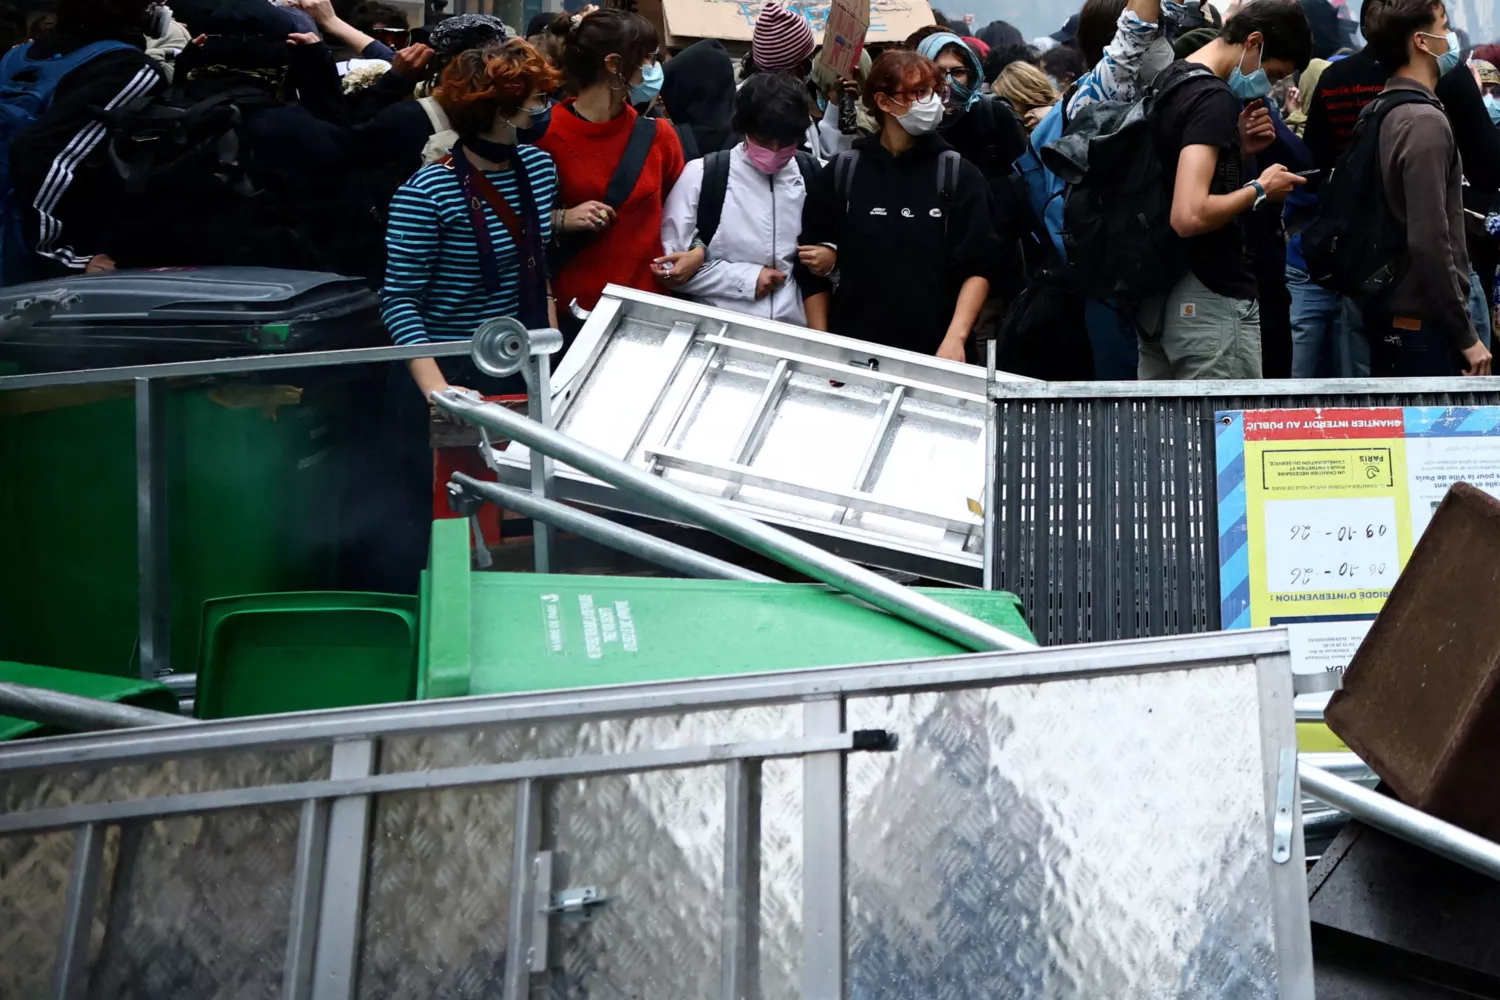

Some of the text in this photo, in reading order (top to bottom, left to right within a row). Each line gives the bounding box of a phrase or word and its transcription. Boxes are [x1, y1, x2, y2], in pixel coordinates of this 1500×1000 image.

[1246, 422, 1283, 430] PUBLIC
[1304, 420, 1349, 428] INTERDIT
[1352, 420, 1401, 428] CHANTIER
[1276, 592, 1356, 602] D'INTERVENTION
